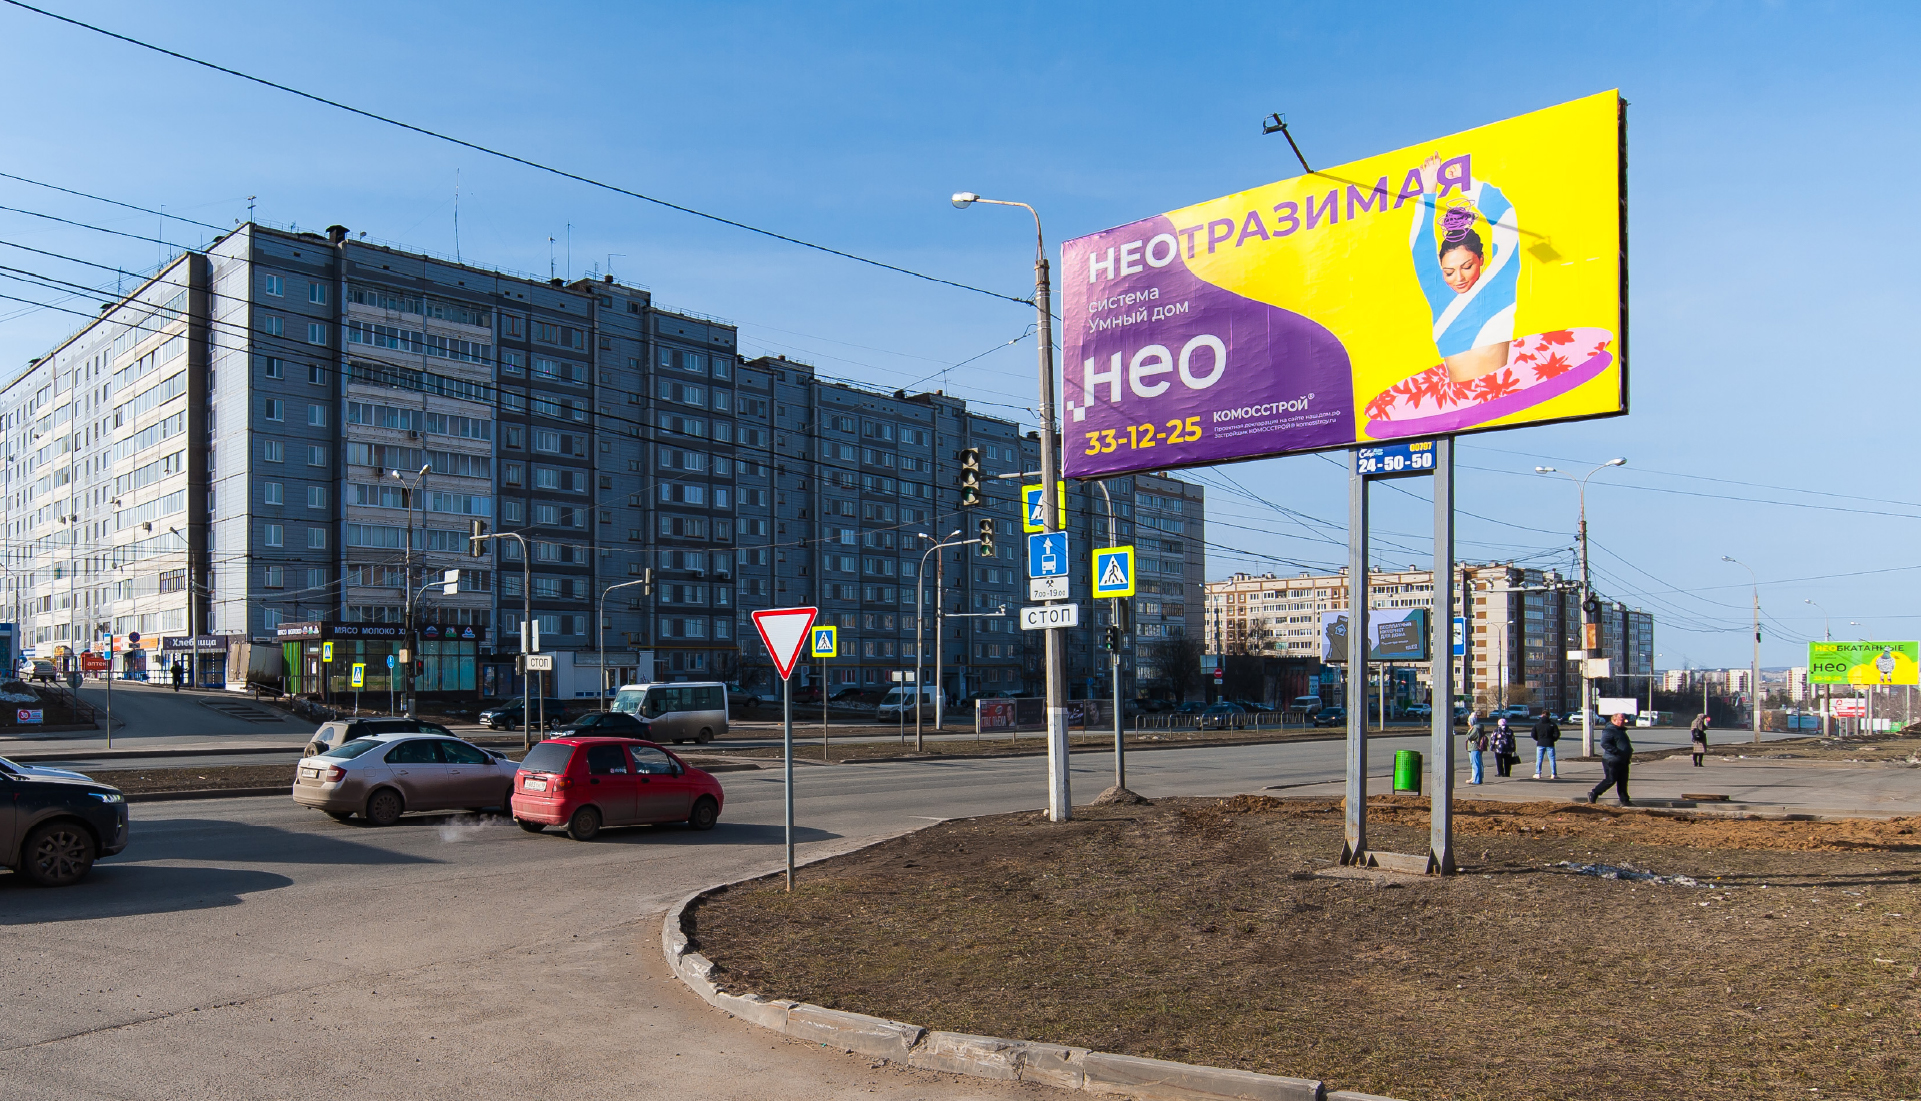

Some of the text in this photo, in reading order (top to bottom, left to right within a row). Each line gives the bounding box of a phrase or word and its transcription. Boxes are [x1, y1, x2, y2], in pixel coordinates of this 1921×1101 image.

[1089, 153, 1471, 284] НЕОТРАЗИМАЯ
[1088, 287, 1160, 313] система
[1088, 300, 1190, 334] Умный дом
[1083, 334, 1227, 408] нео
[1084, 415, 1203, 456] 33-12-25
[1409, 441, 1433, 452] 00797
[1028, 608, 1070, 624] СТОП
[334, 626, 358, 634] МЯСО
[361, 627, 395, 635] МОЛОКО
[530, 657, 549, 668] СТОП
[1813, 663, 1847, 672] нео
